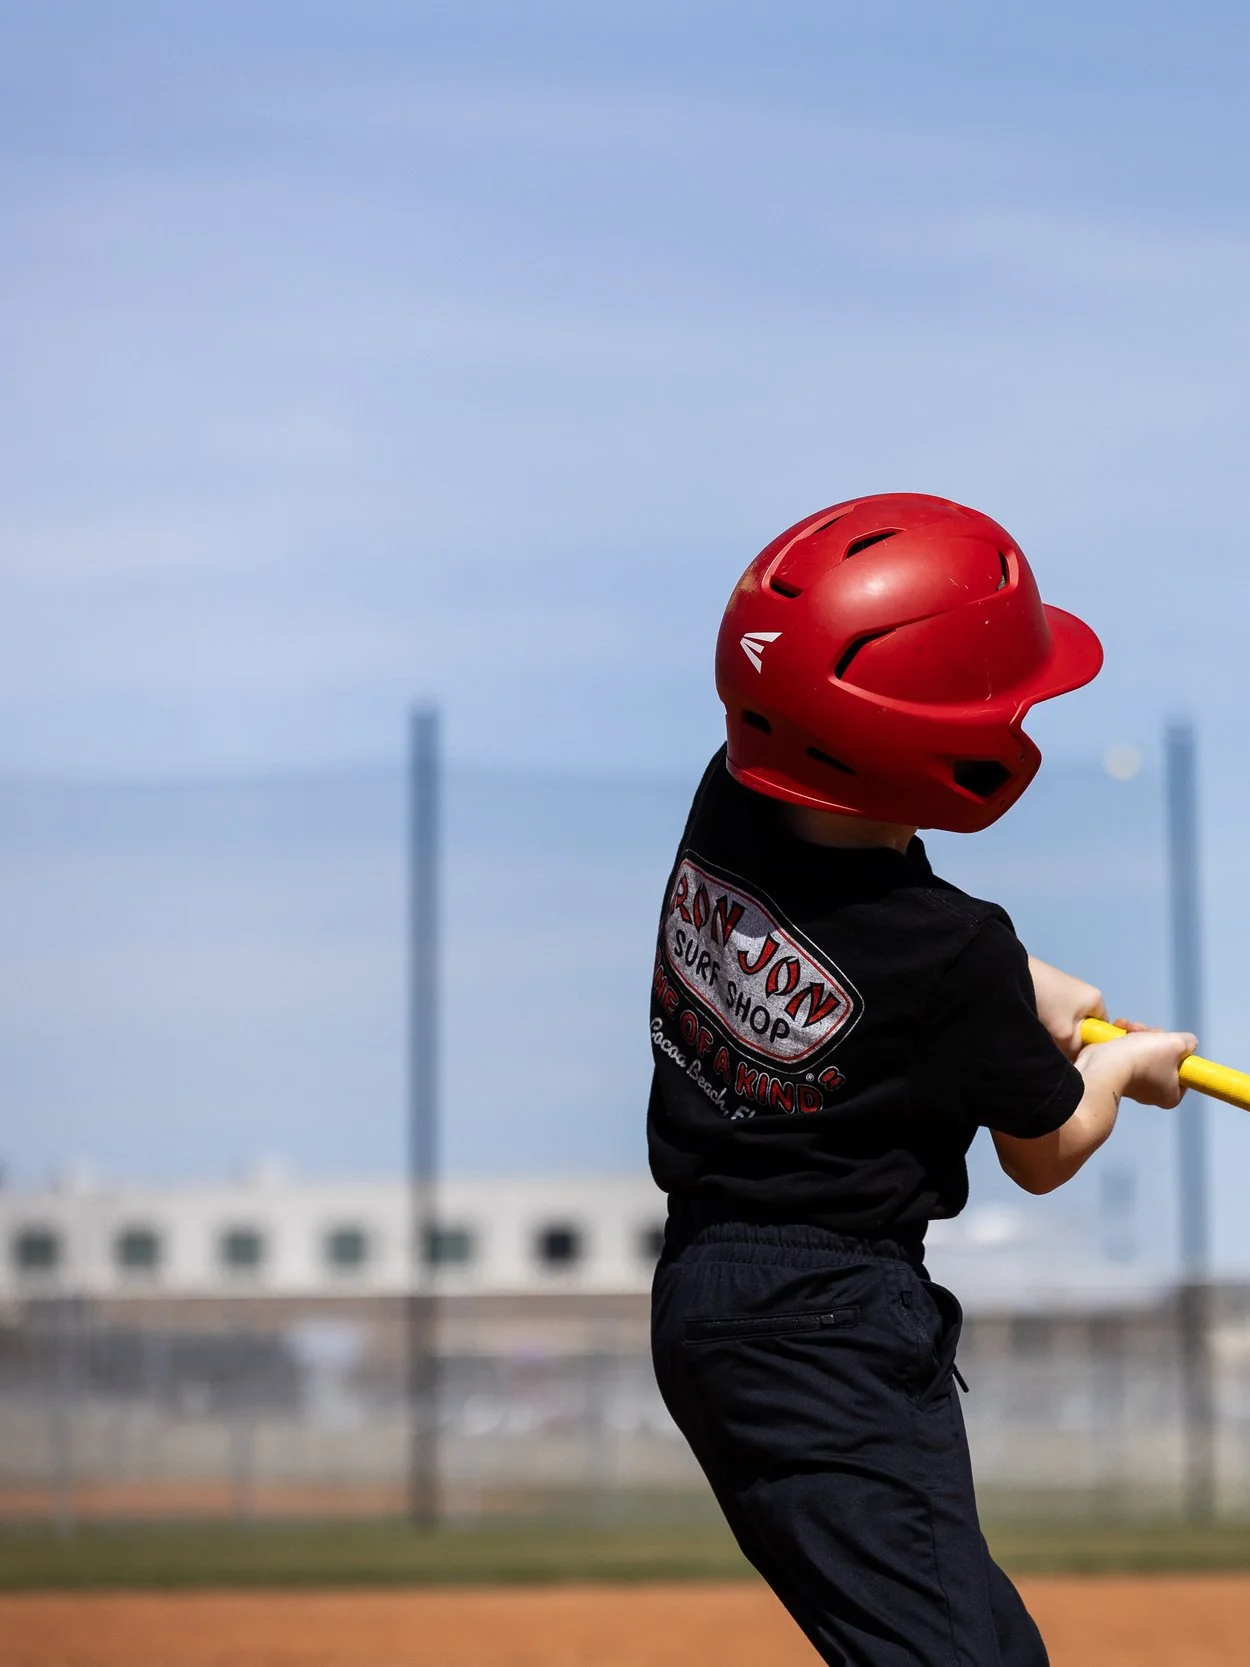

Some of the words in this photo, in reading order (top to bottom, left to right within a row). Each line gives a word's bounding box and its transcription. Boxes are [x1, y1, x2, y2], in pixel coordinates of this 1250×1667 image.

[671, 873, 746, 948] RON
[737, 932, 841, 1028] JON
[673, 929, 721, 987] SURF
[726, 981, 790, 1043] SHOP
[651, 1017, 687, 1068] Cocoa
[680, 1009, 714, 1058] OF
[714, 1046, 733, 1085] A
